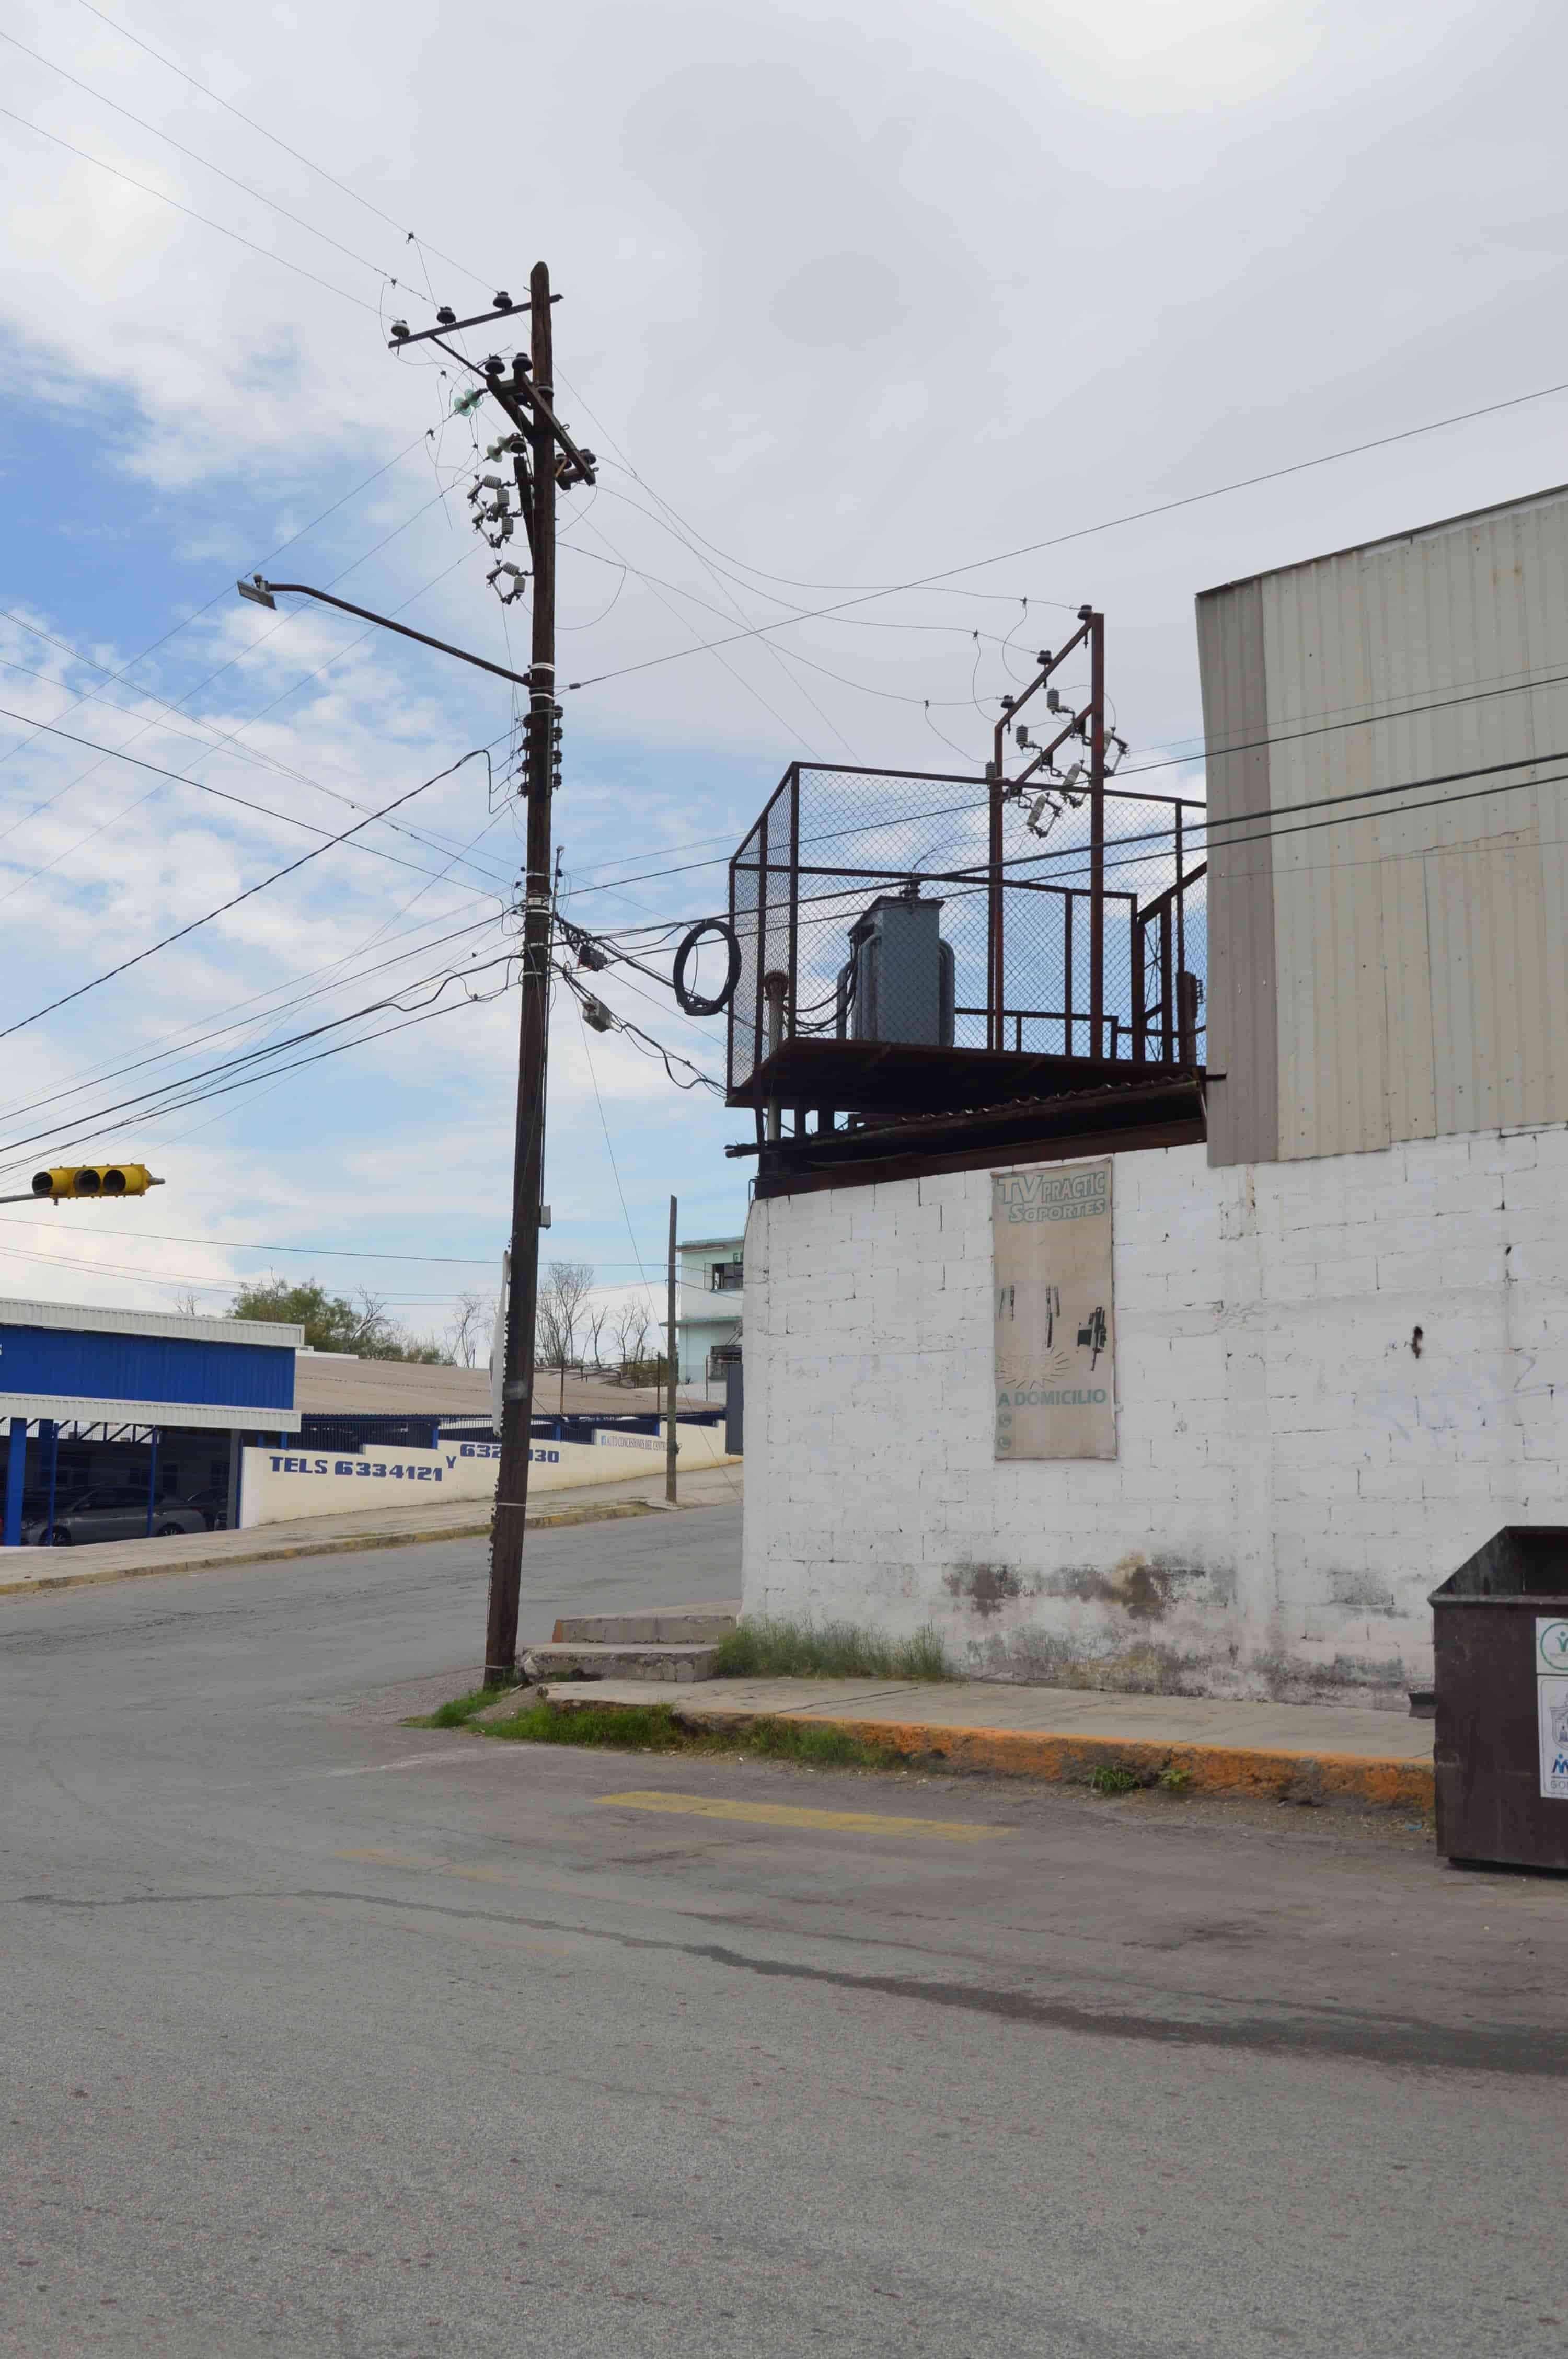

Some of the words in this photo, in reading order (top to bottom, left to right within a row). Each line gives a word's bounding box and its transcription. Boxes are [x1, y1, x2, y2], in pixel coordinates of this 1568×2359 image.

[997, 1175, 1043, 1204] TV
[1040, 1171, 1105, 1203] PRACTIC
[1009, 1199, 1105, 1223] SOPORTES
[998, 1392, 1010, 1406] A
[1014, 1389, 1106, 1406] DOMICILIO
[269, 1456, 328, 1474] TELS
[335, 1461, 442, 1481] 6334121
[446, 1455, 456, 1469] Y
